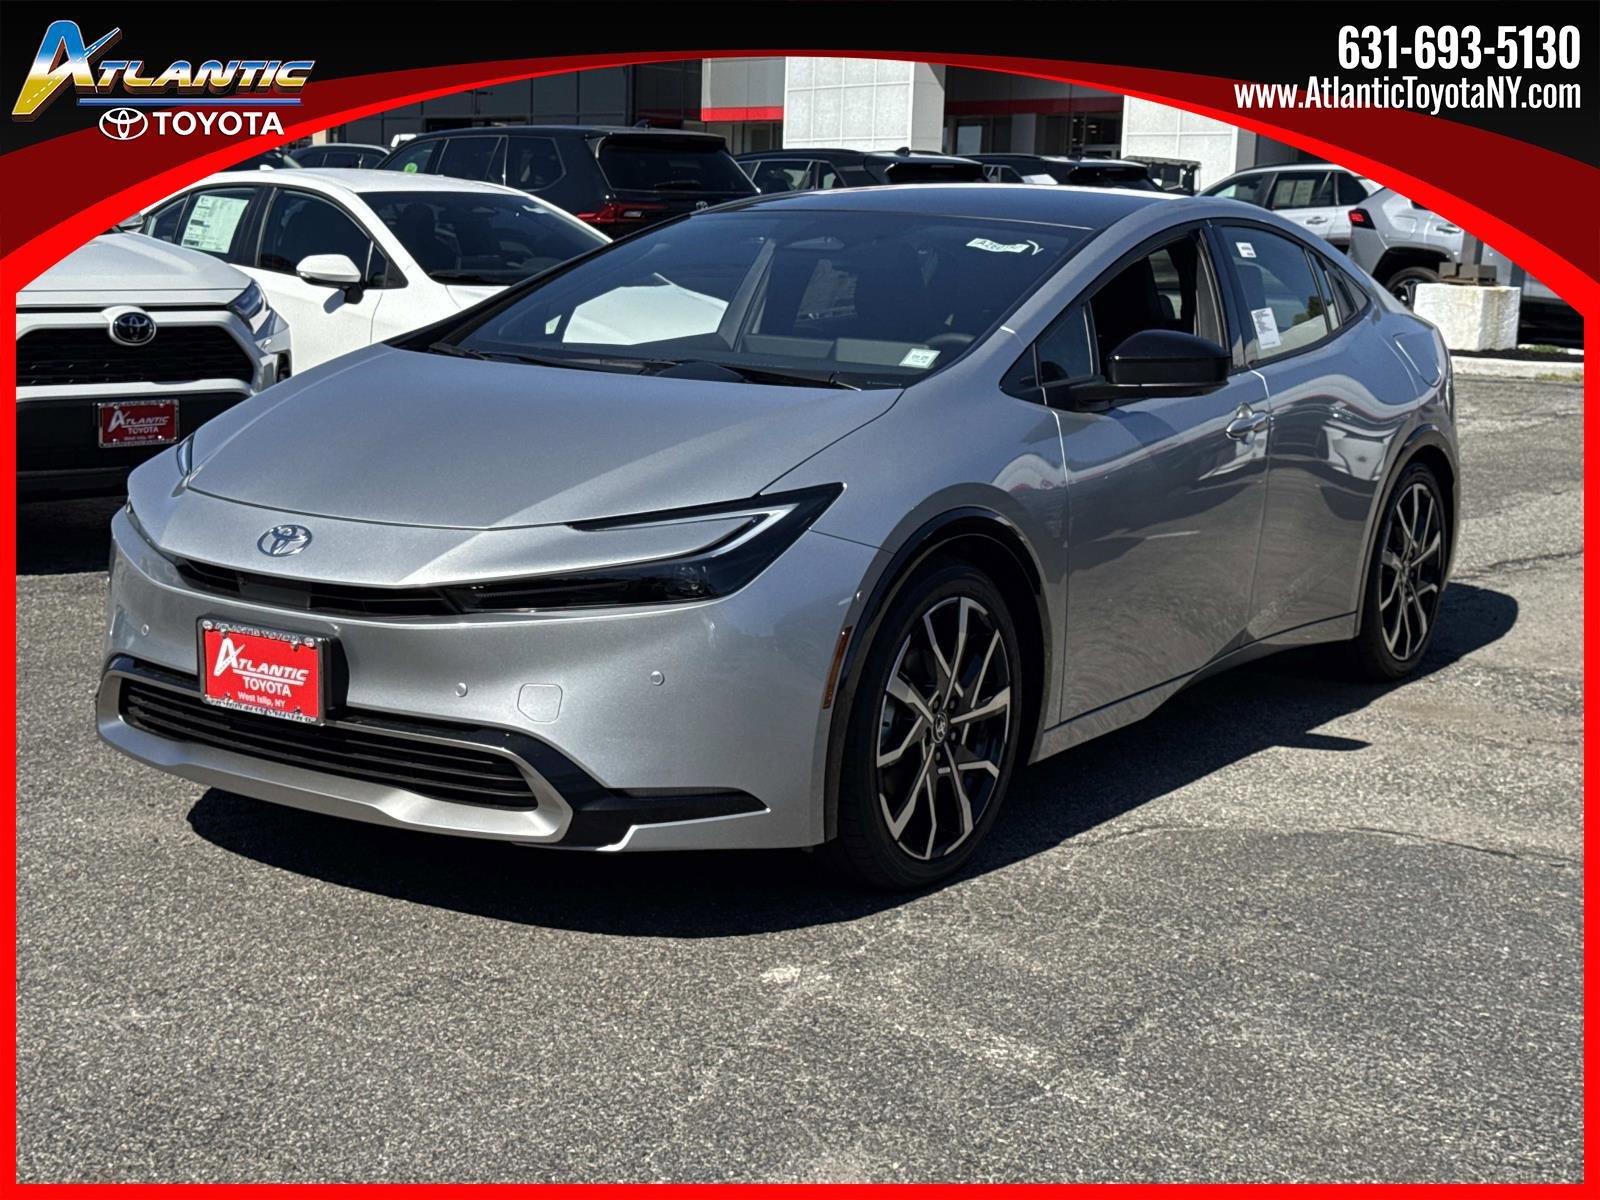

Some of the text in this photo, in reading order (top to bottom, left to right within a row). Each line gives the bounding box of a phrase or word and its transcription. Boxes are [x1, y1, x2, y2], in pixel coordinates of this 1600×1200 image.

[213, 637, 309, 682] ATLANTIC
[242, 676, 292, 698] TOYOTA
[237, 690, 256, 702] West
[275, 698, 287, 708] NY
